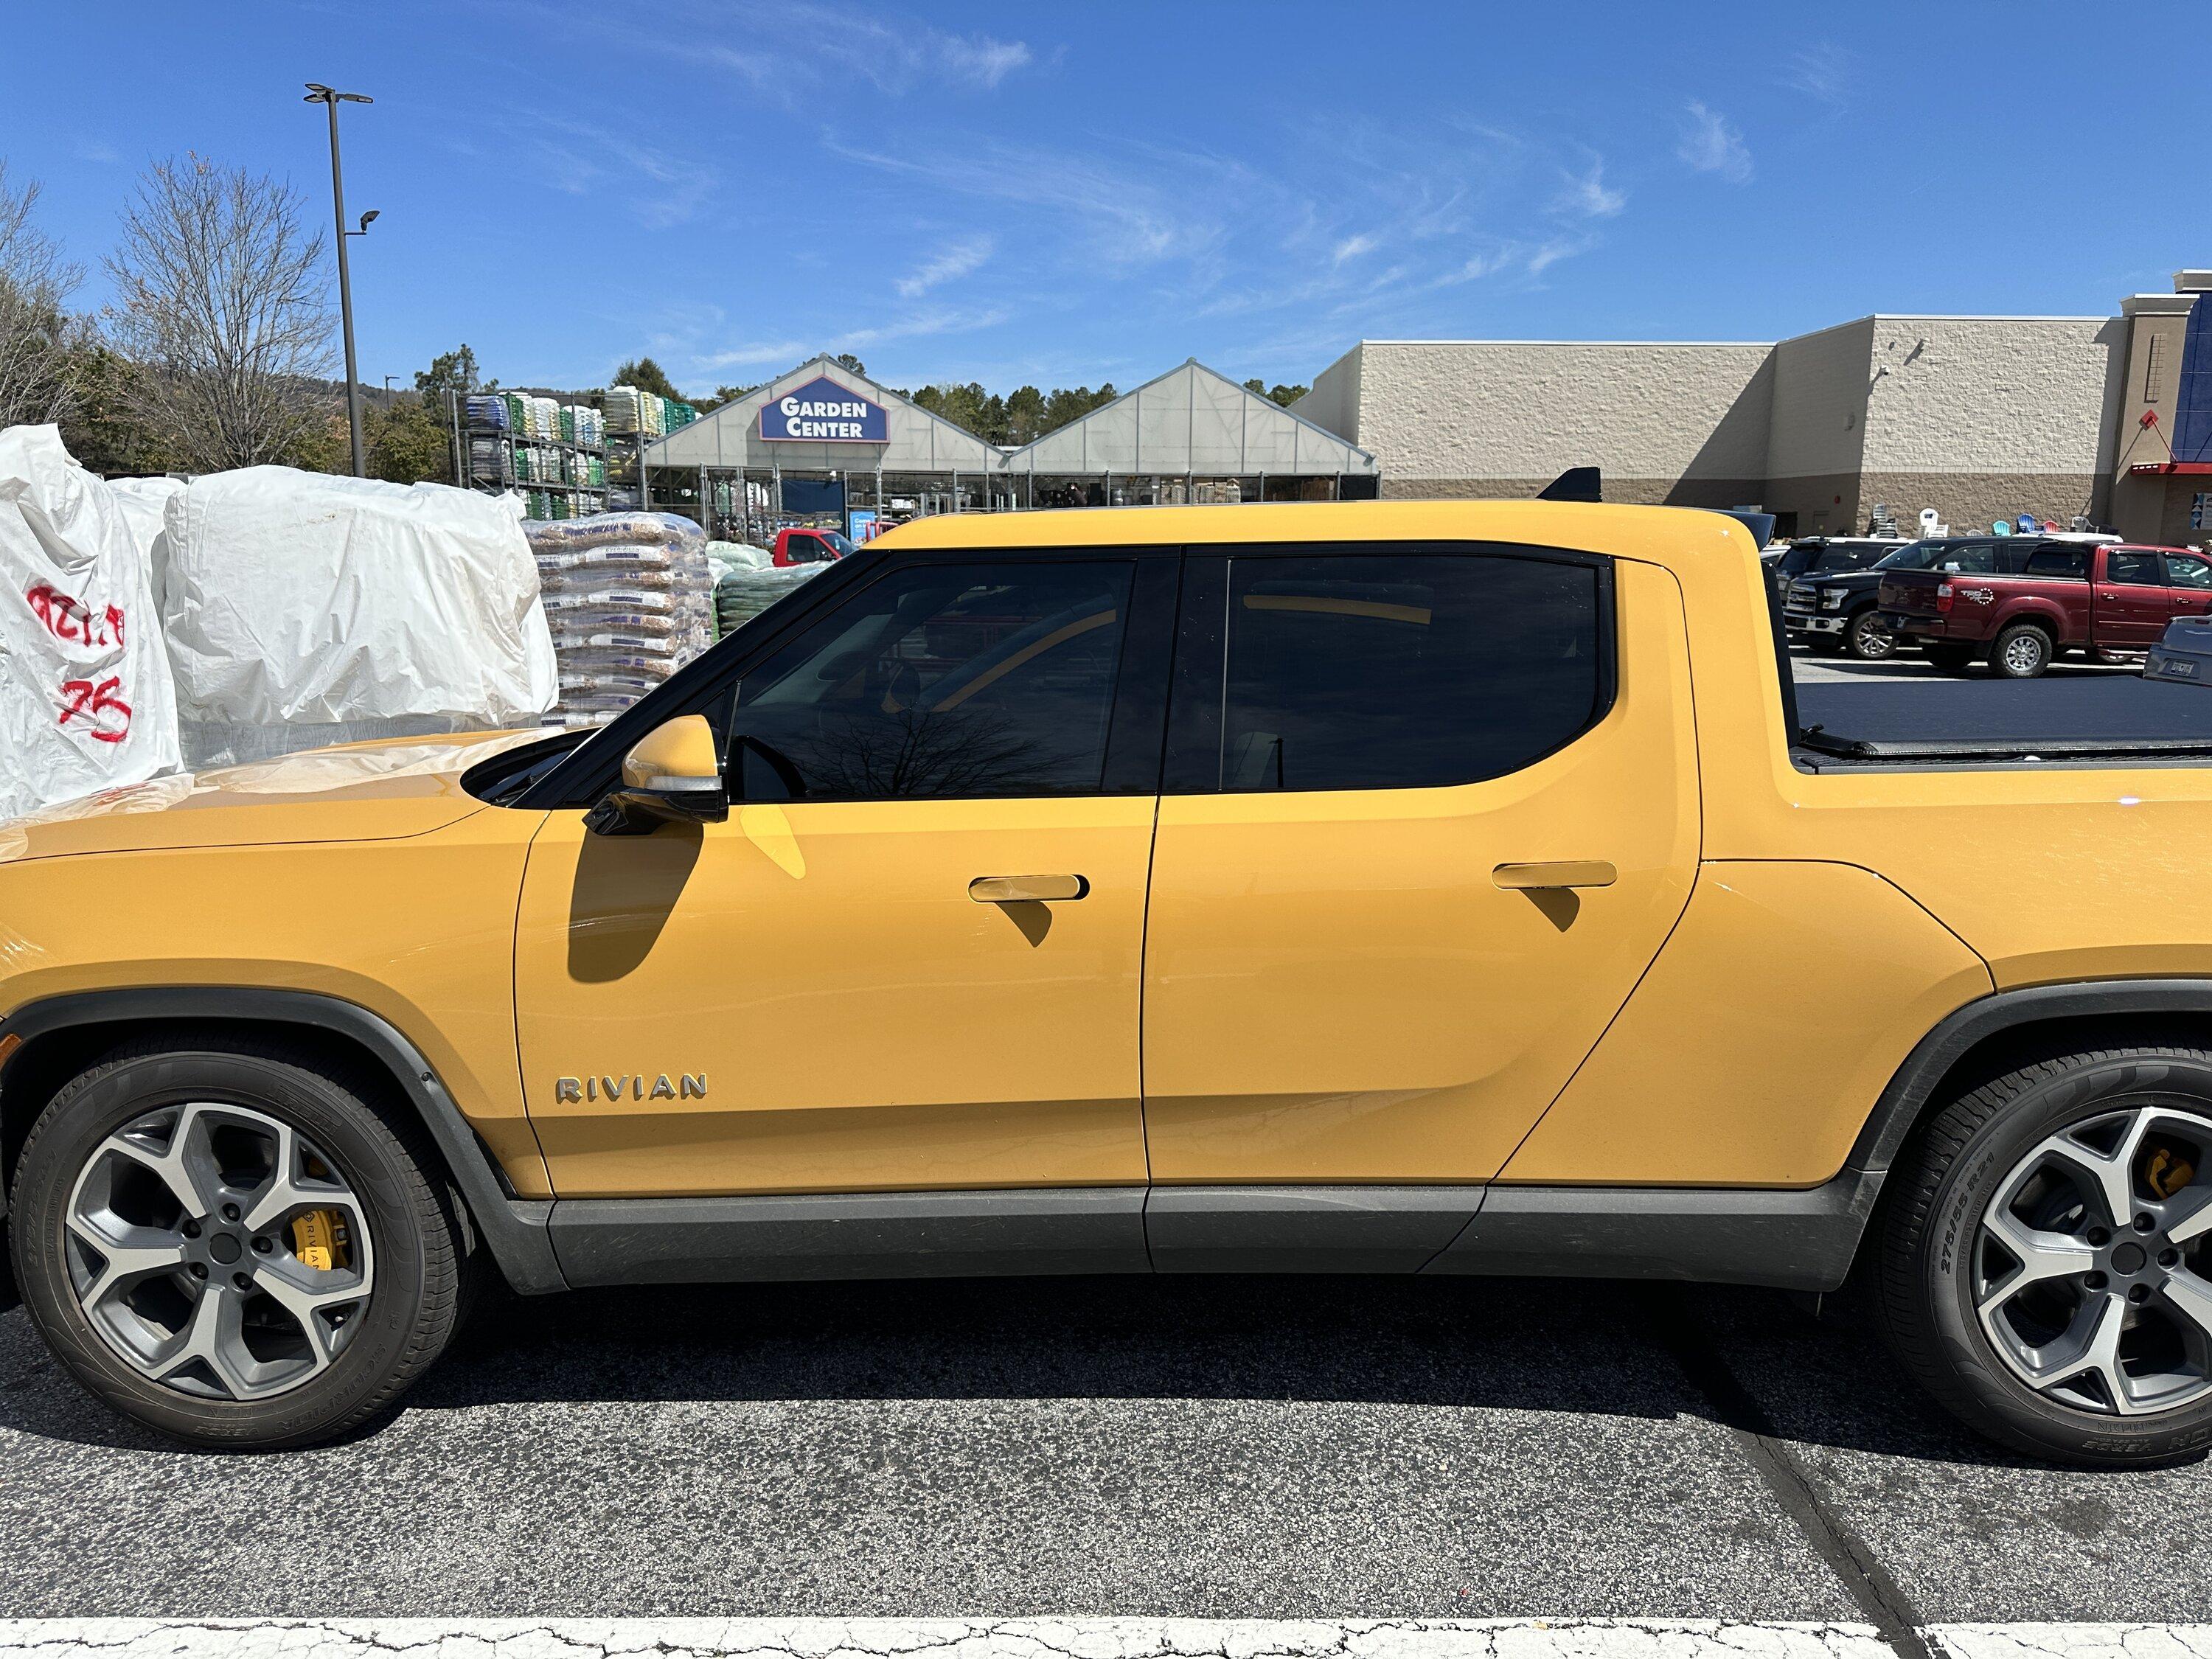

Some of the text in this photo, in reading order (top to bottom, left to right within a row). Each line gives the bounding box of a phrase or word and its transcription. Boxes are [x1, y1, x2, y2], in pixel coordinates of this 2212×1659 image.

[780, 397, 866, 417] GARDEN
[786, 417, 863, 437] CENTER
[557, 1073, 708, 1101] RIVIAN
[1941, 1193, 1968, 1274] 275/55
[1967, 1152, 1994, 1192] R21
